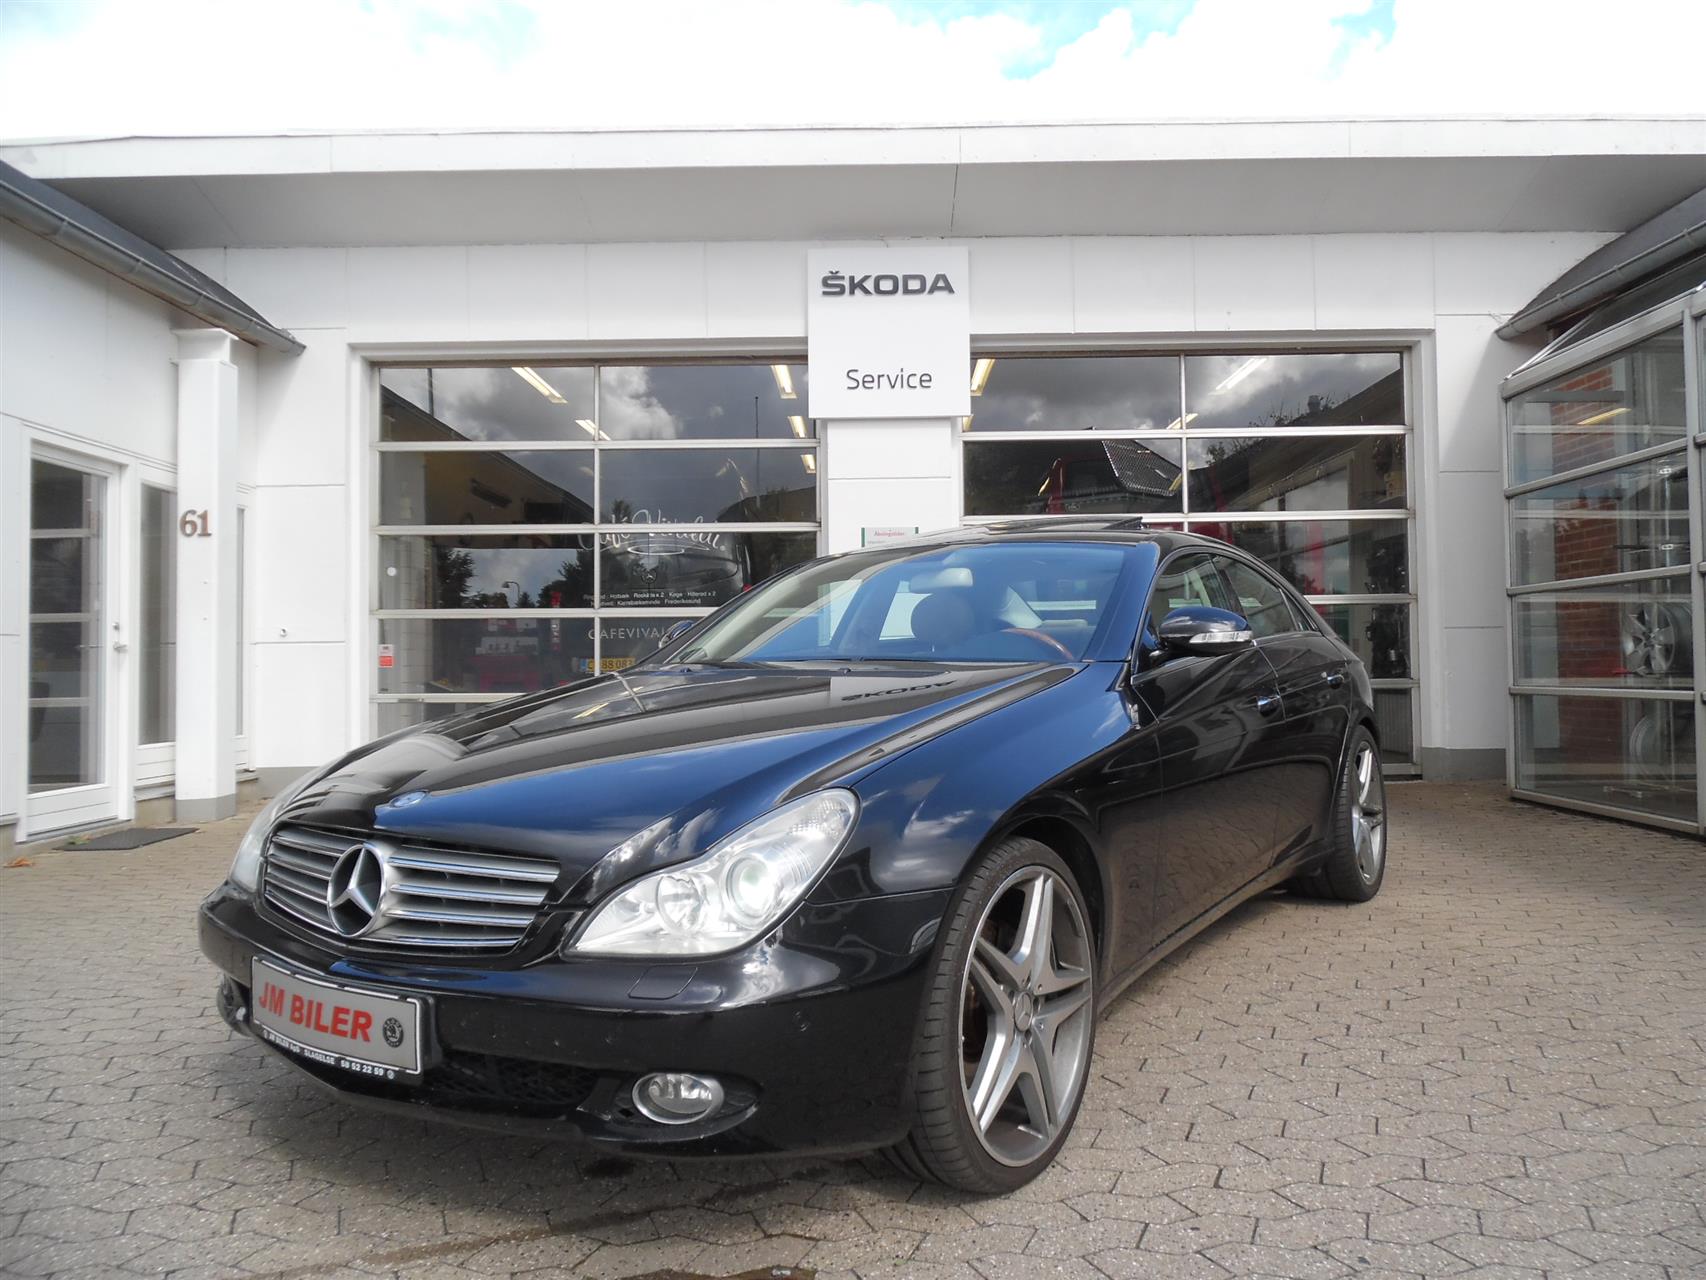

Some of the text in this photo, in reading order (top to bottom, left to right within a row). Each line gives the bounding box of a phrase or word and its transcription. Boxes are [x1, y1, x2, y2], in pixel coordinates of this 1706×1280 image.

[821, 270, 955, 296] ŠKODA
[846, 367, 932, 390] Service
[179, 509, 212, 538] 61
[259, 982, 373, 1042] JM BILER
[303, 1048, 335, 1065] SLAGELSE
[362, 1064, 373, 1074] 22
